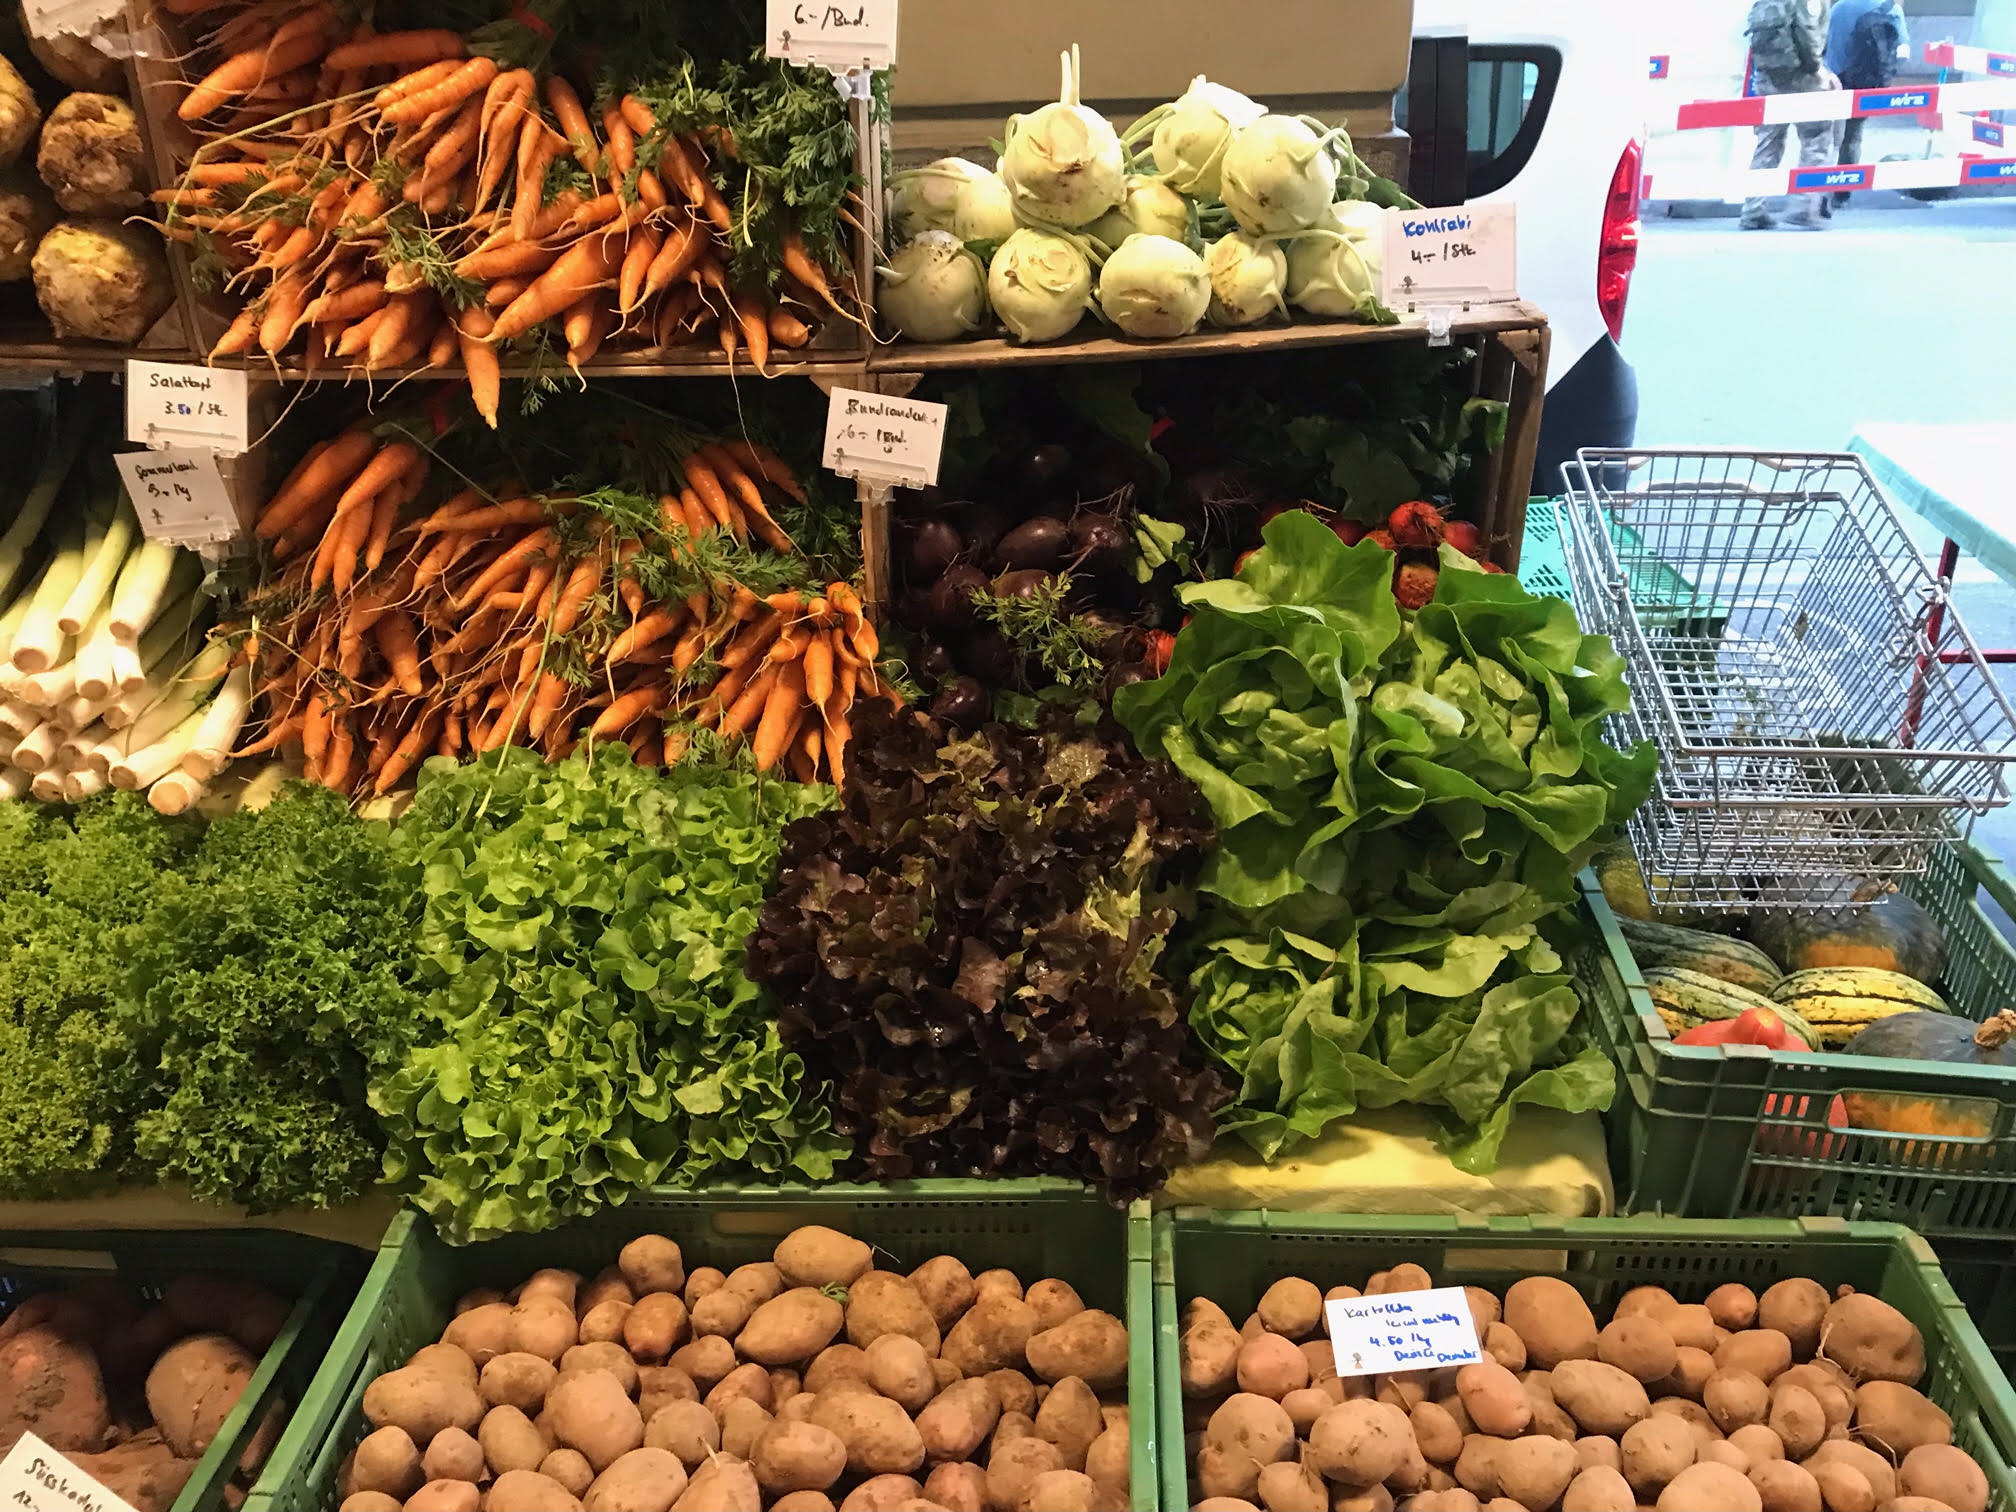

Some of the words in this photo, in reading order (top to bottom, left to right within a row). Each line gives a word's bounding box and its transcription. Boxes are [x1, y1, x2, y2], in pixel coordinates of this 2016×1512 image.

[1890, 93, 1924, 107] wirz
[1825, 171, 1860, 185] wirz
[1402, 214, 1471, 238] Kohlrabi
